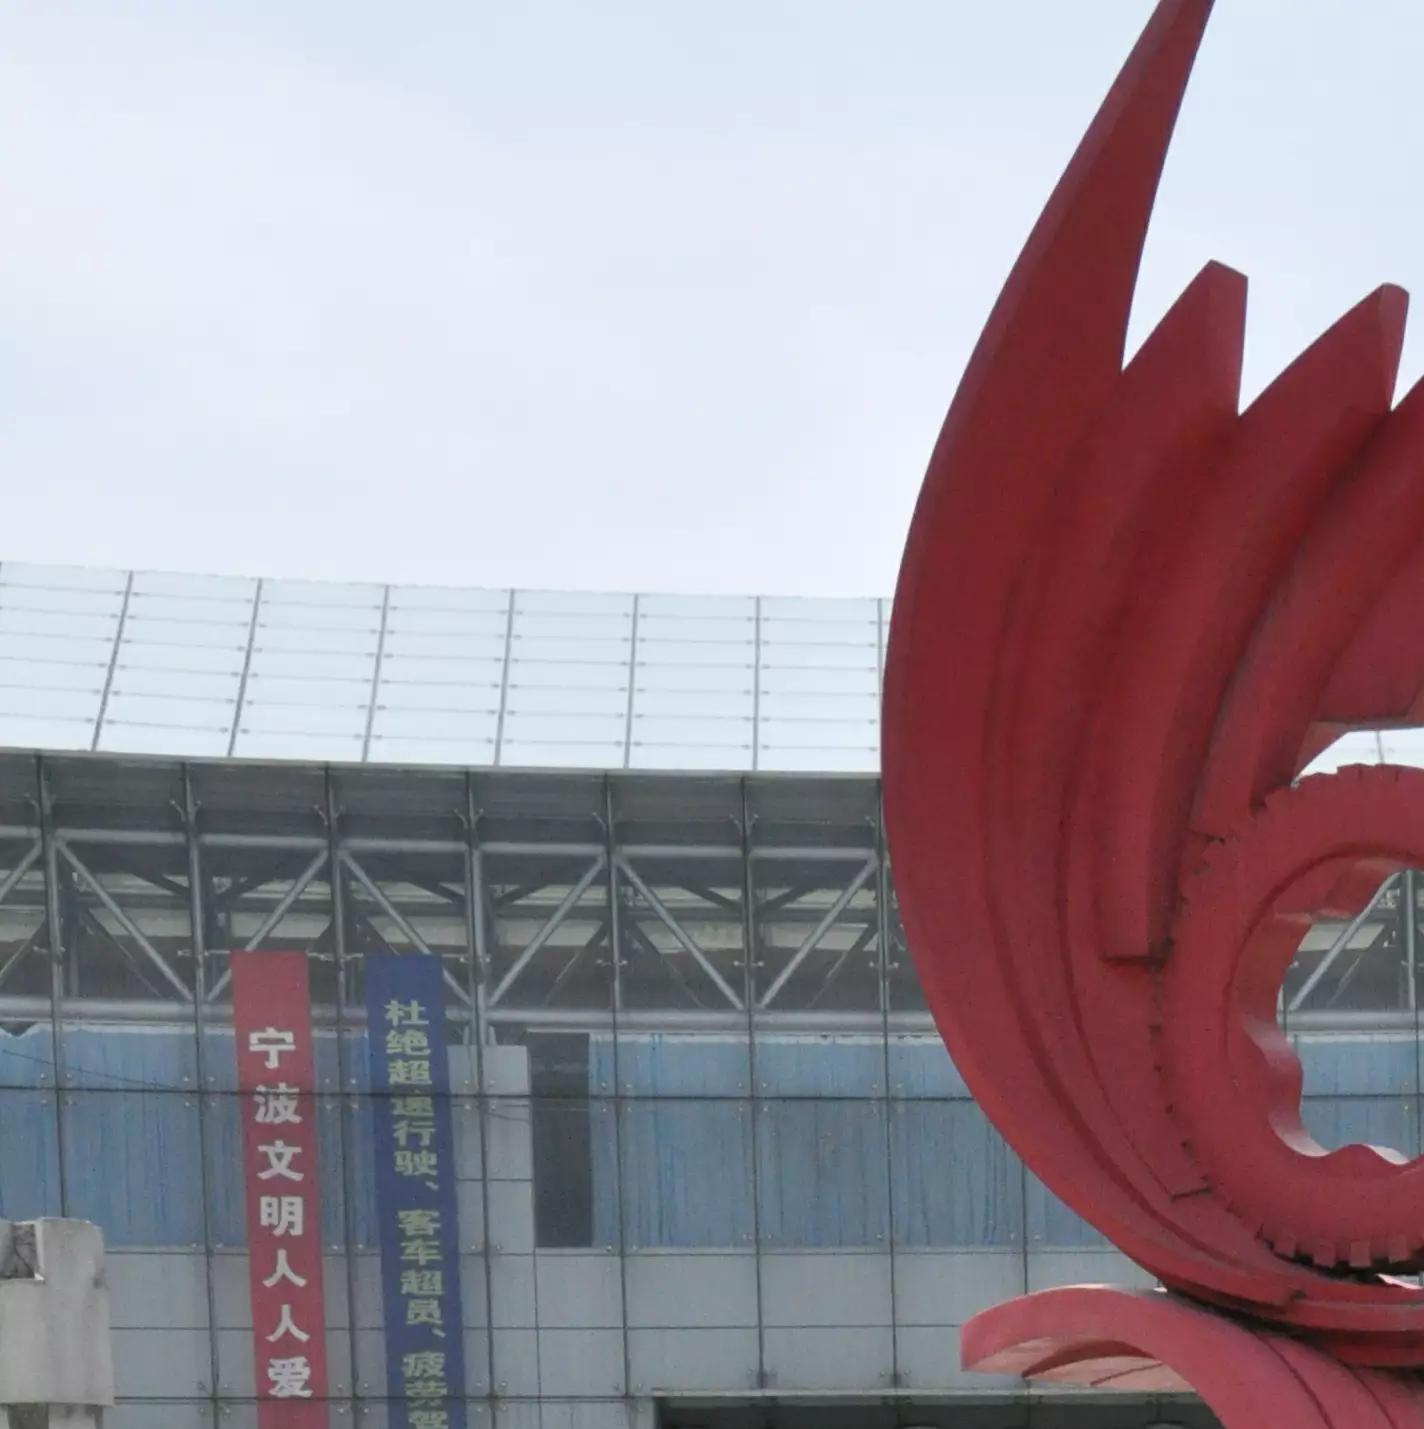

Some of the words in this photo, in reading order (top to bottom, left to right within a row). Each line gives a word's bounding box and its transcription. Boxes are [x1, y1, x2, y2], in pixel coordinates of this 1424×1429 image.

[248, 1026, 313, 1399] 宁波文明人人爱
